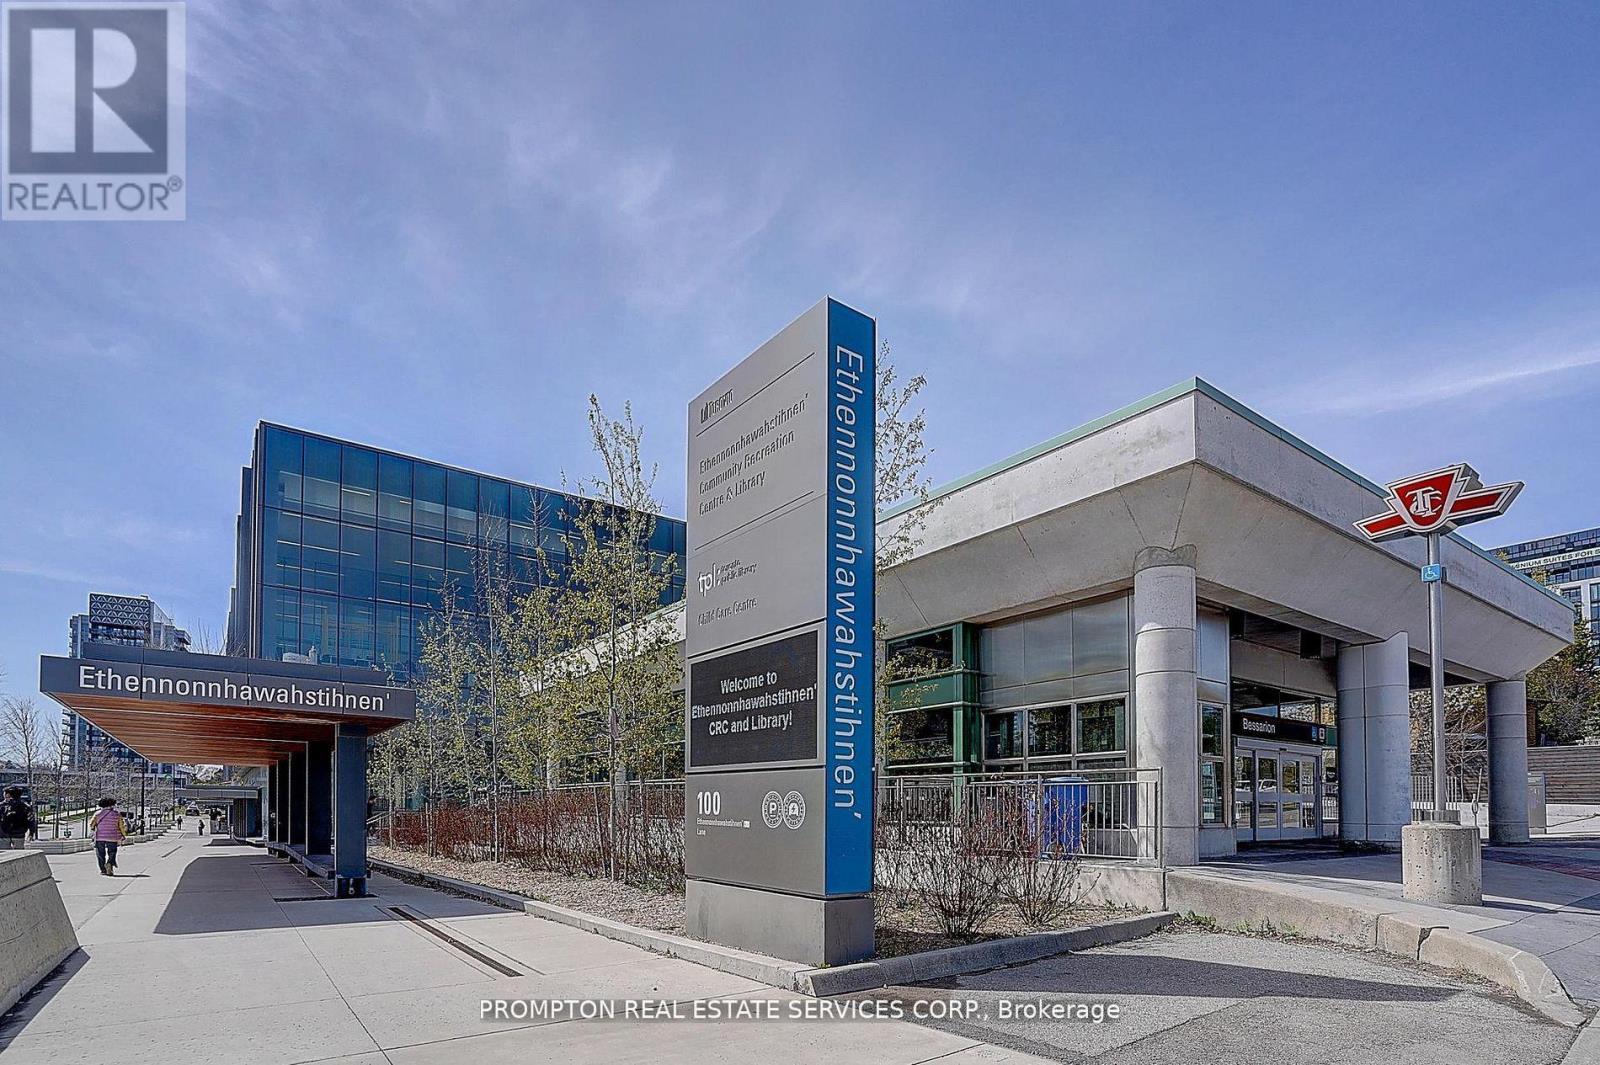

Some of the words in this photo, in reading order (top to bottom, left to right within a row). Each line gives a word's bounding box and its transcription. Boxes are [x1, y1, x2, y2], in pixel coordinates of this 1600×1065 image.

[699, 461, 743, 495] Community
[744, 430, 794, 469] Recreation
[699, 494, 724, 517] Centre
[726, 486, 733, 502] &
[735, 470, 766, 497] Library
[1543, 554, 1573, 564] SUITES
[1575, 550, 1593, 558] FOR
[733, 597, 757, 615] Centre
[720, 673, 765, 695] Welcome
[766, 671, 778, 686] to
[709, 719, 729, 736] CRC
[731, 715, 750, 732] and
[751, 710, 793, 732] Library!
[697, 791, 721, 816] 100
